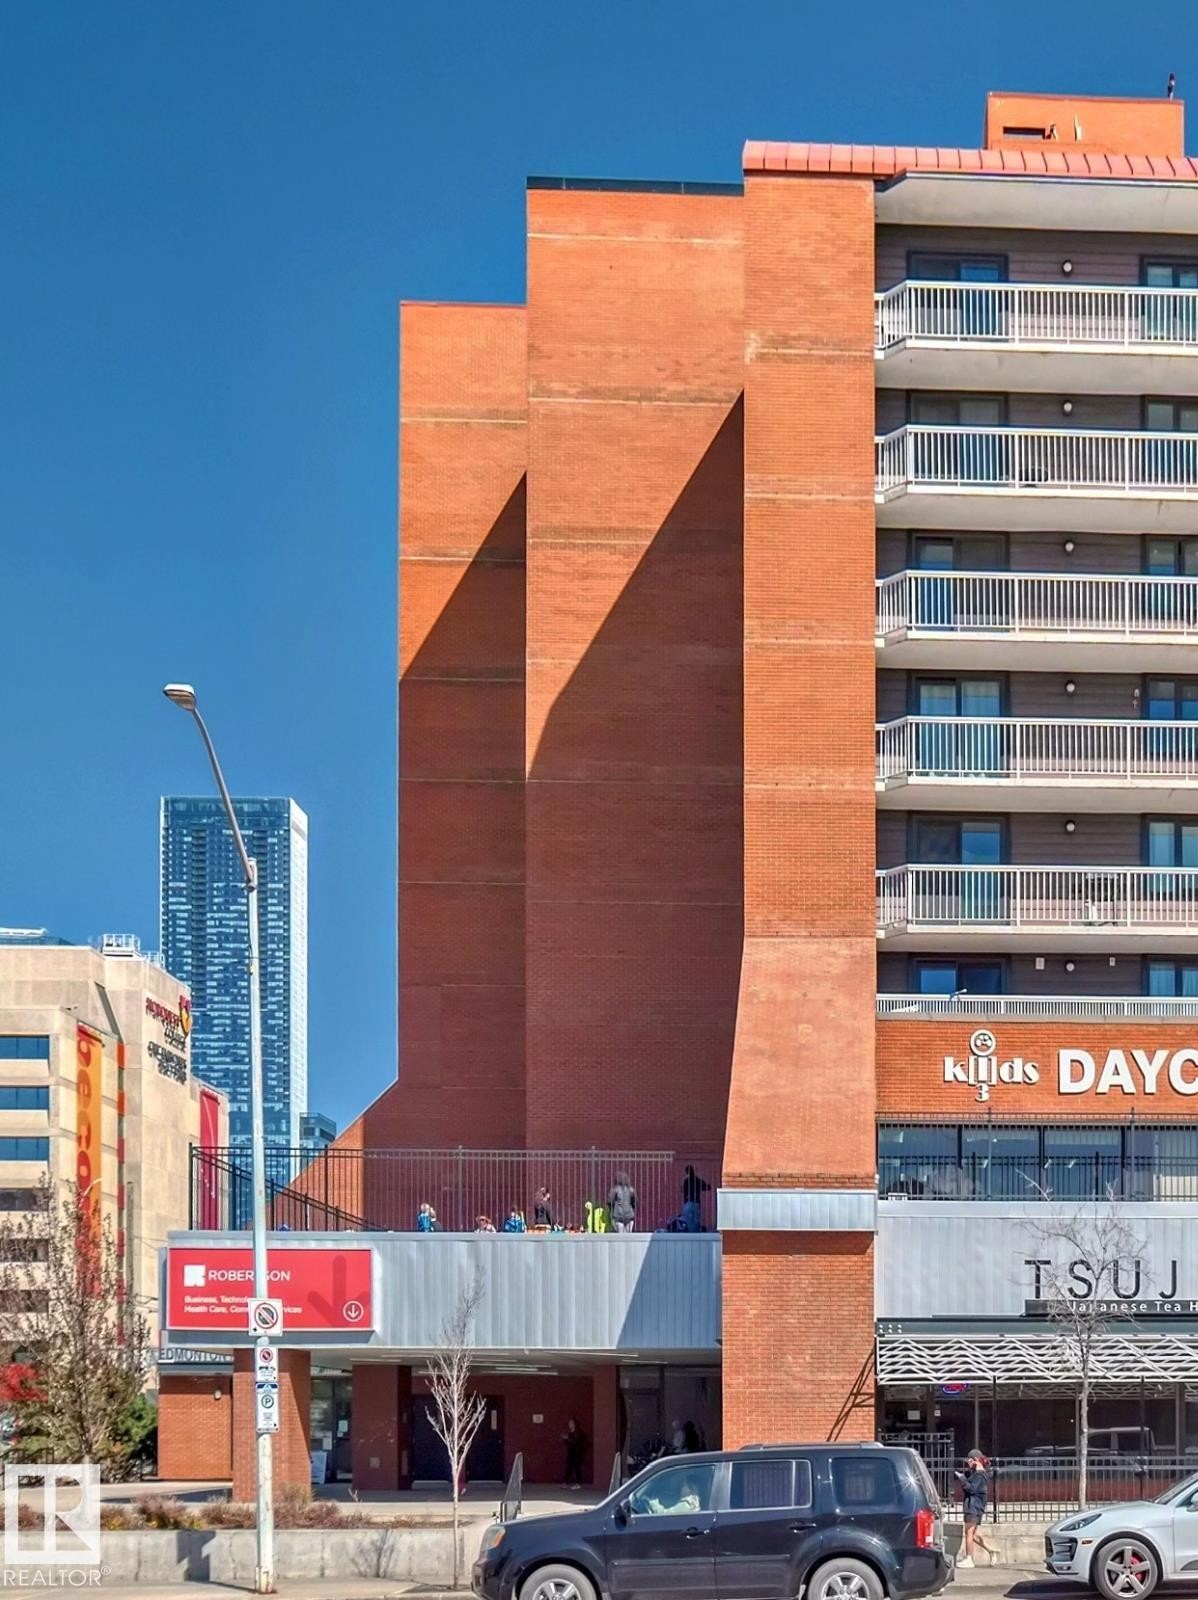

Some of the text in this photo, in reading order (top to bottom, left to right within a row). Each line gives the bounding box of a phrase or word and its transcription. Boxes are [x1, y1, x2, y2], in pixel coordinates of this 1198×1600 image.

[208, 1269, 291, 1282] ROBERON
[184, 1305, 208, 1313] Health
[1154, 1300, 1182, 1312] Tea
